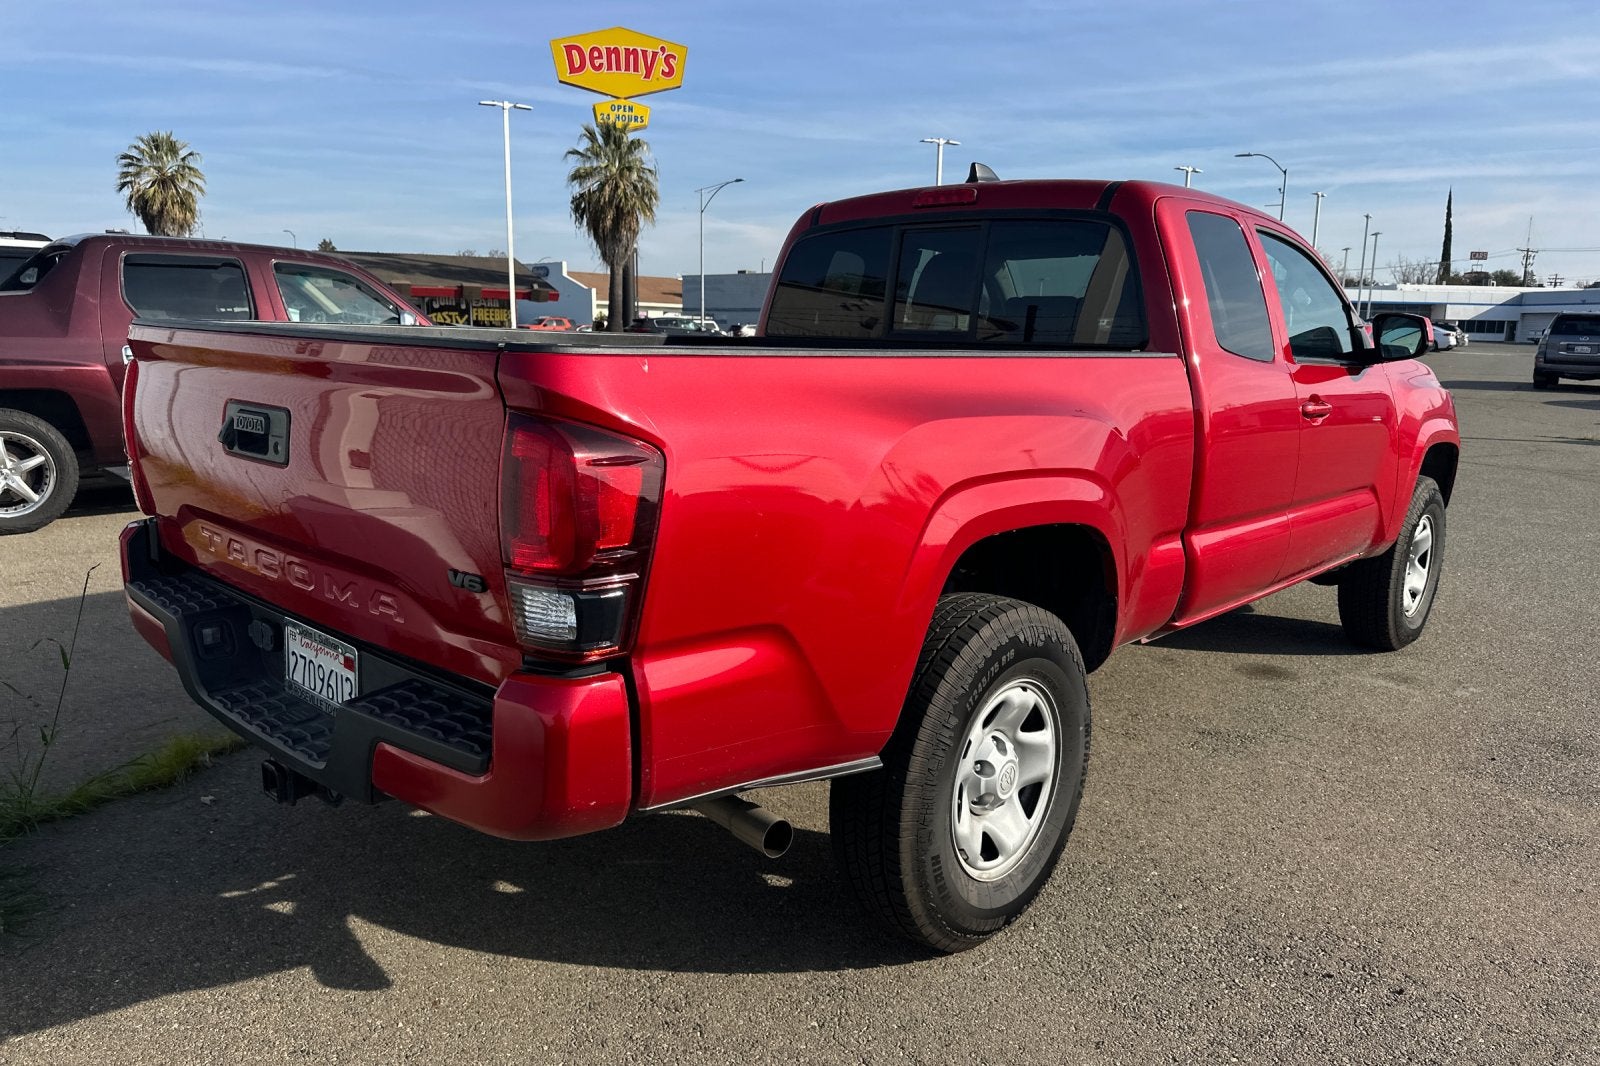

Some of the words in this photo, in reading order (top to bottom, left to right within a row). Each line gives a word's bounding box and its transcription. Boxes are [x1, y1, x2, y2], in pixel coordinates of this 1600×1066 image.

[563, 44, 678, 81] Denny's
[610, 103, 634, 113] OPEN
[600, 112, 611, 121] 24
[615, 113, 645, 124] HOURS
[1471, 252, 1488, 260] CARS
[233, 415, 265, 432] TOYOTA
[200, 525, 405, 624] TACOMA
[448, 569, 484, 593] V6
